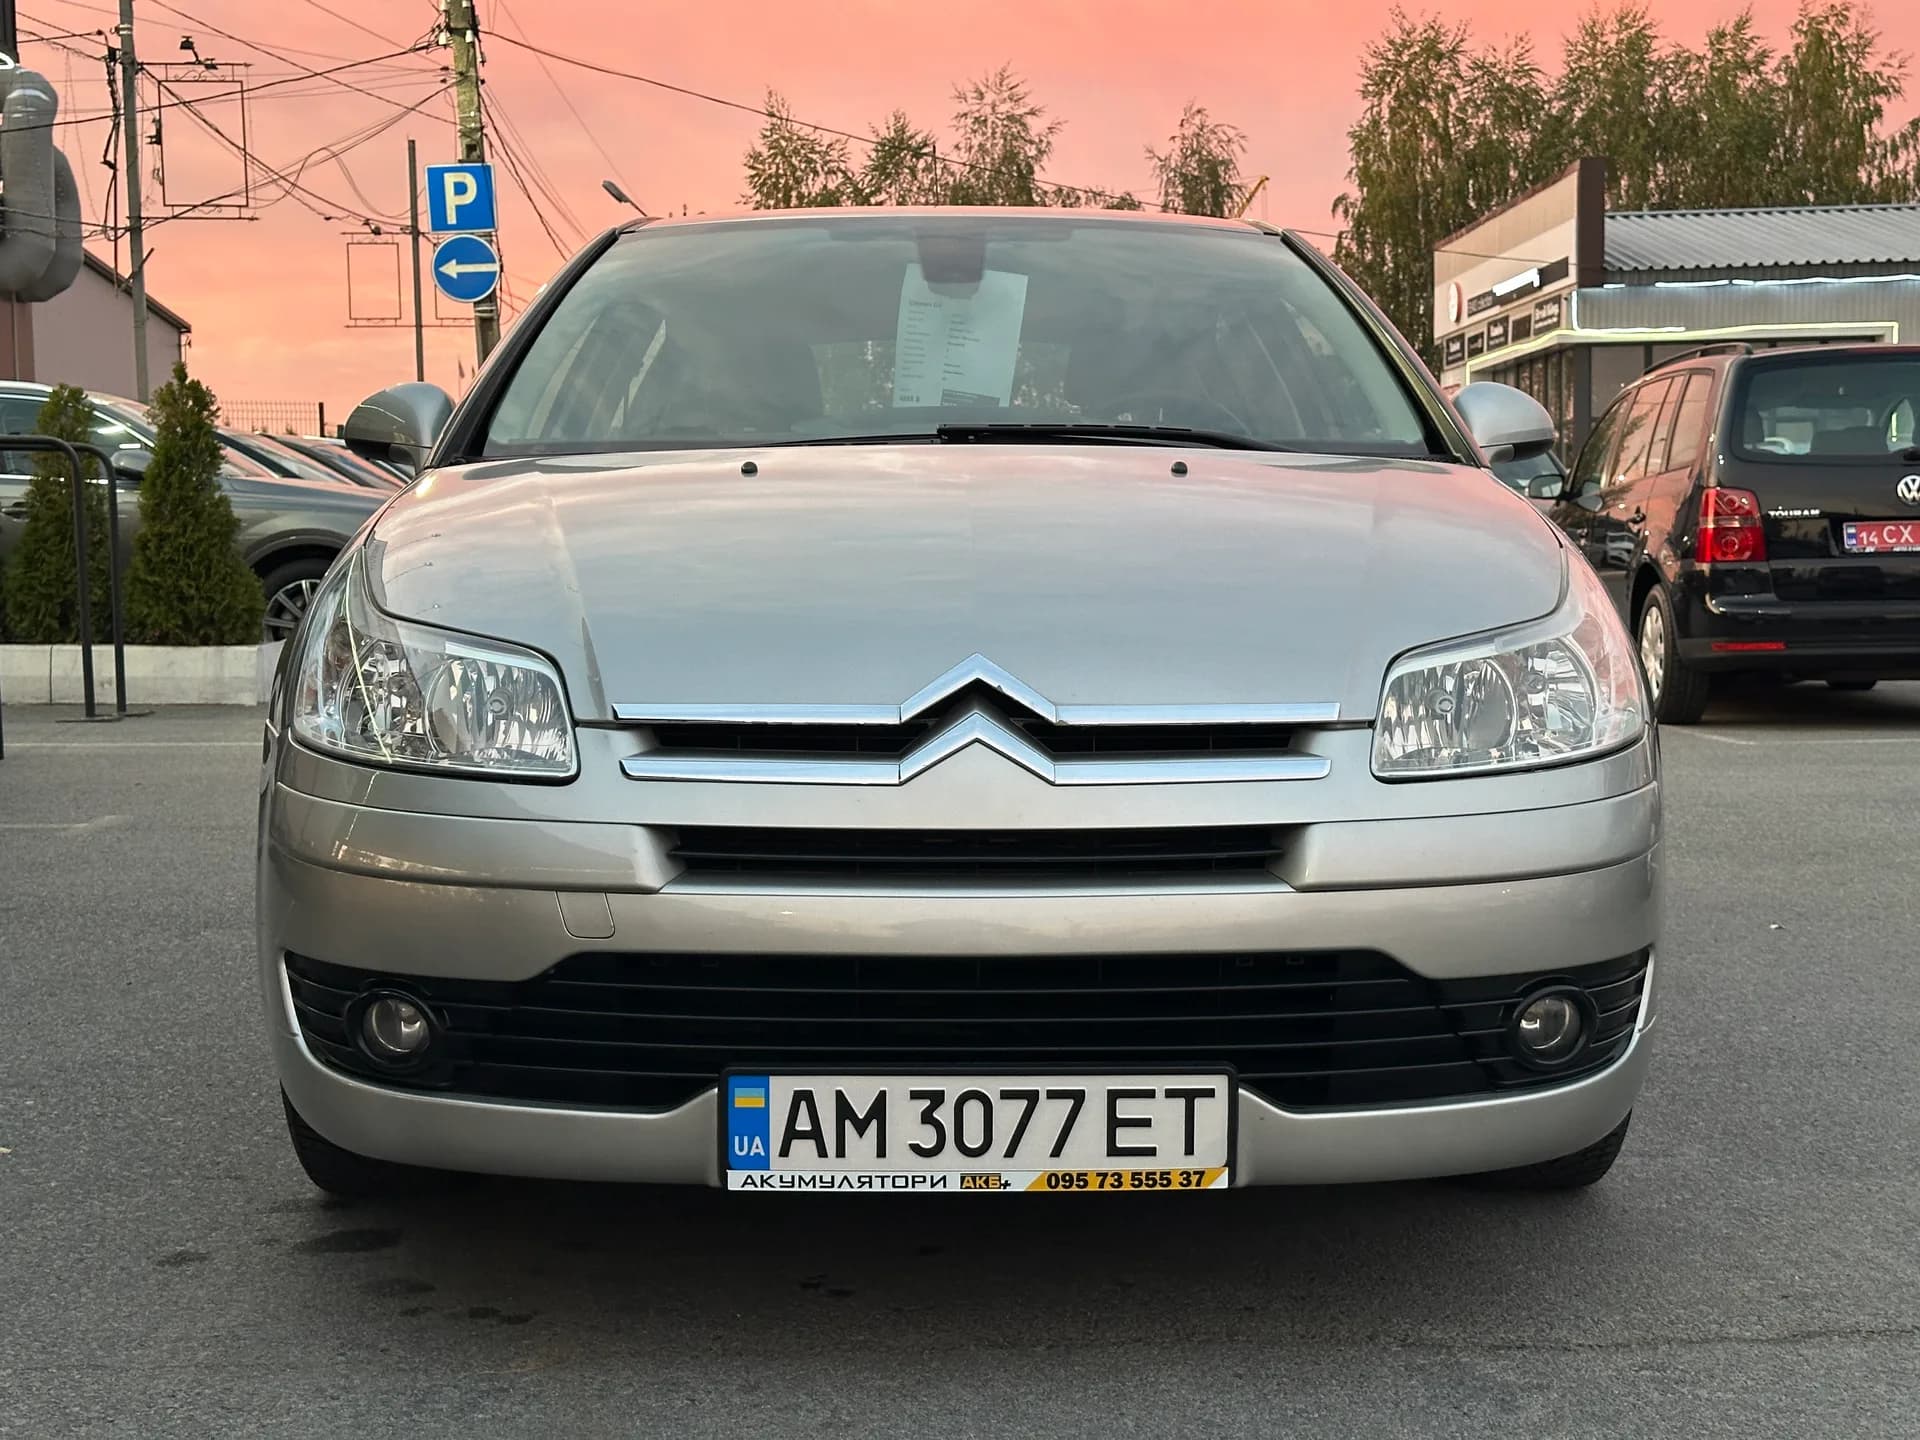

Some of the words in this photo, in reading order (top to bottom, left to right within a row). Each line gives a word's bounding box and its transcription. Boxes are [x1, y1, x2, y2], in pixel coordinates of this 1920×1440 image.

[443, 172, 477, 225] P
[1859, 531, 1879, 545] 14
[1882, 524, 1915, 544] CX
[778, 1088, 887, 1158] AM
[908, 1088, 1086, 1158] 3077
[1106, 1087, 1216, 1157] ET
[734, 1135, 765, 1156] UA
[741, 1174, 947, 1189] АКУМУЛЯТОРИ
[1046, 1172, 1089, 1189] 095
[1096, 1172, 1123, 1188] 73
[1130, 1171, 1172, 1188] 555
[1178, 1170, 1206, 1187] 37
